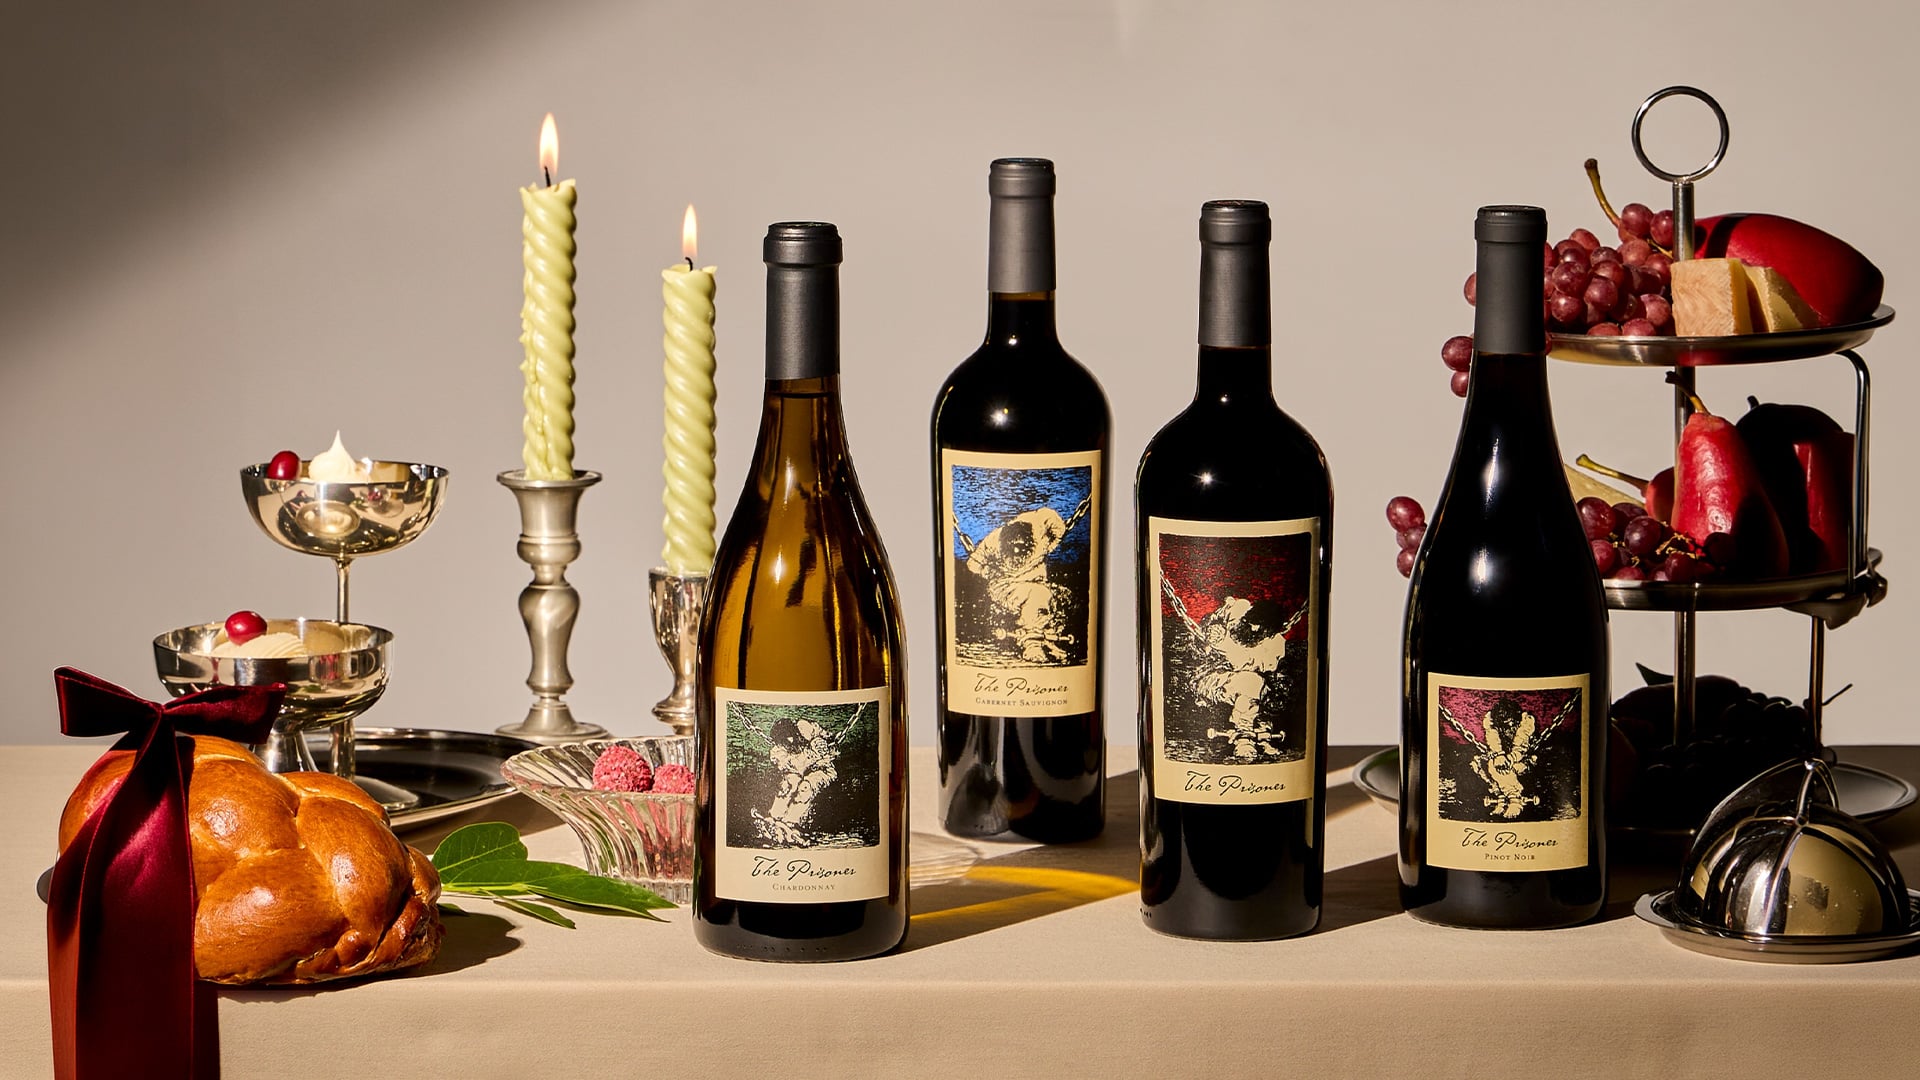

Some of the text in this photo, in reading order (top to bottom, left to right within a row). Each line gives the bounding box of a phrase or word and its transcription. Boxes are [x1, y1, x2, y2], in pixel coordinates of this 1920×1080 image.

[974, 673, 1069, 697] The Prisoner
[1184, 770, 1286, 796] The Prisoner
[1461, 827, 1558, 851] The Prisoner
[751, 855, 857, 881] The Prisoner
